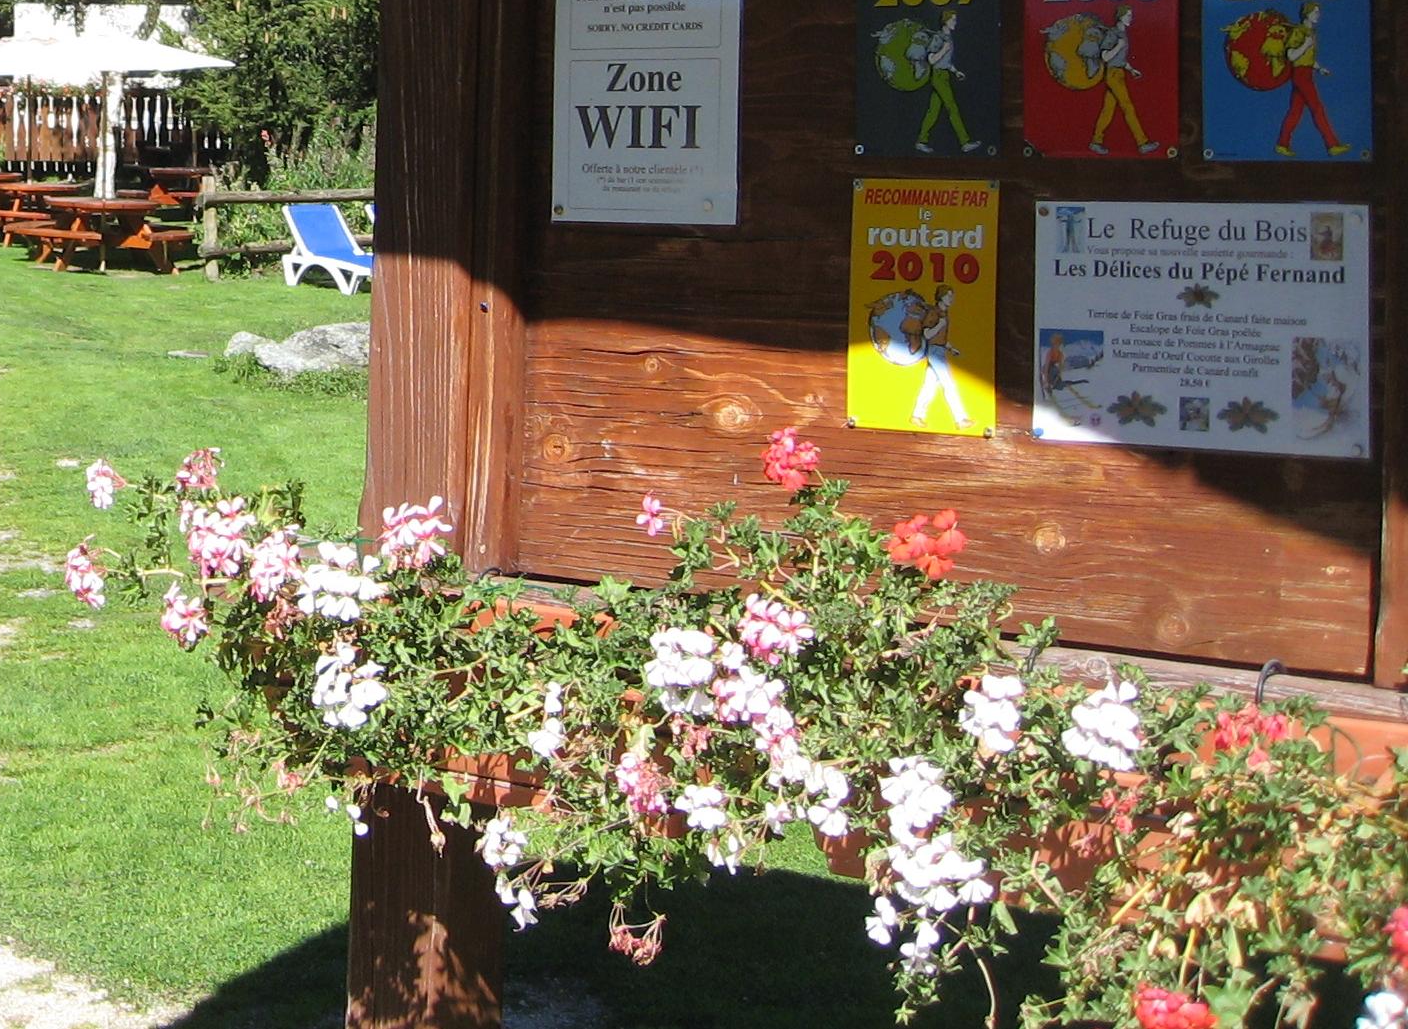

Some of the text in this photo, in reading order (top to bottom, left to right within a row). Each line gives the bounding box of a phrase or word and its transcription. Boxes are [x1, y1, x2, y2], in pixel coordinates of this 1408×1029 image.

[604, 1, 686, 15] n'est pas possible
[621, 23, 634, 32] NO
[636, 22, 670, 31] CREDIT
[672, 22, 703, 30] CARDS
[606, 63, 682, 92] Zone
[575, 105, 703, 149] WIFI
[582, 164, 613, 174] Offerte
[864, 187, 989, 208] RECOMMANDÉ PAR
[919, 207, 932, 221] le
[867, 223, 985, 249] routard
[1088, 218, 1308, 246] Le Refuge du Bois
[869, 250, 980, 284] 2010
[1054, 259, 1346, 285] Les Délices du Pépé Fernand
[1088, 309, 1307, 326] Terrine de Foie Gras frais de Canard faite maison
[1129, 323, 1170, 335] Escalope
[1172, 325, 1183, 334] de
[1186, 325, 1205, 335] Foie
[1208, 326, 1229, 336] Gras
[1164, 338, 1176, 347] de
[1112, 349, 1149, 359] Marmite
[1243, 355, 1280, 365] Girolles
[1183, 365, 1195, 375] de
[1197, 366, 1229, 376] Canard
